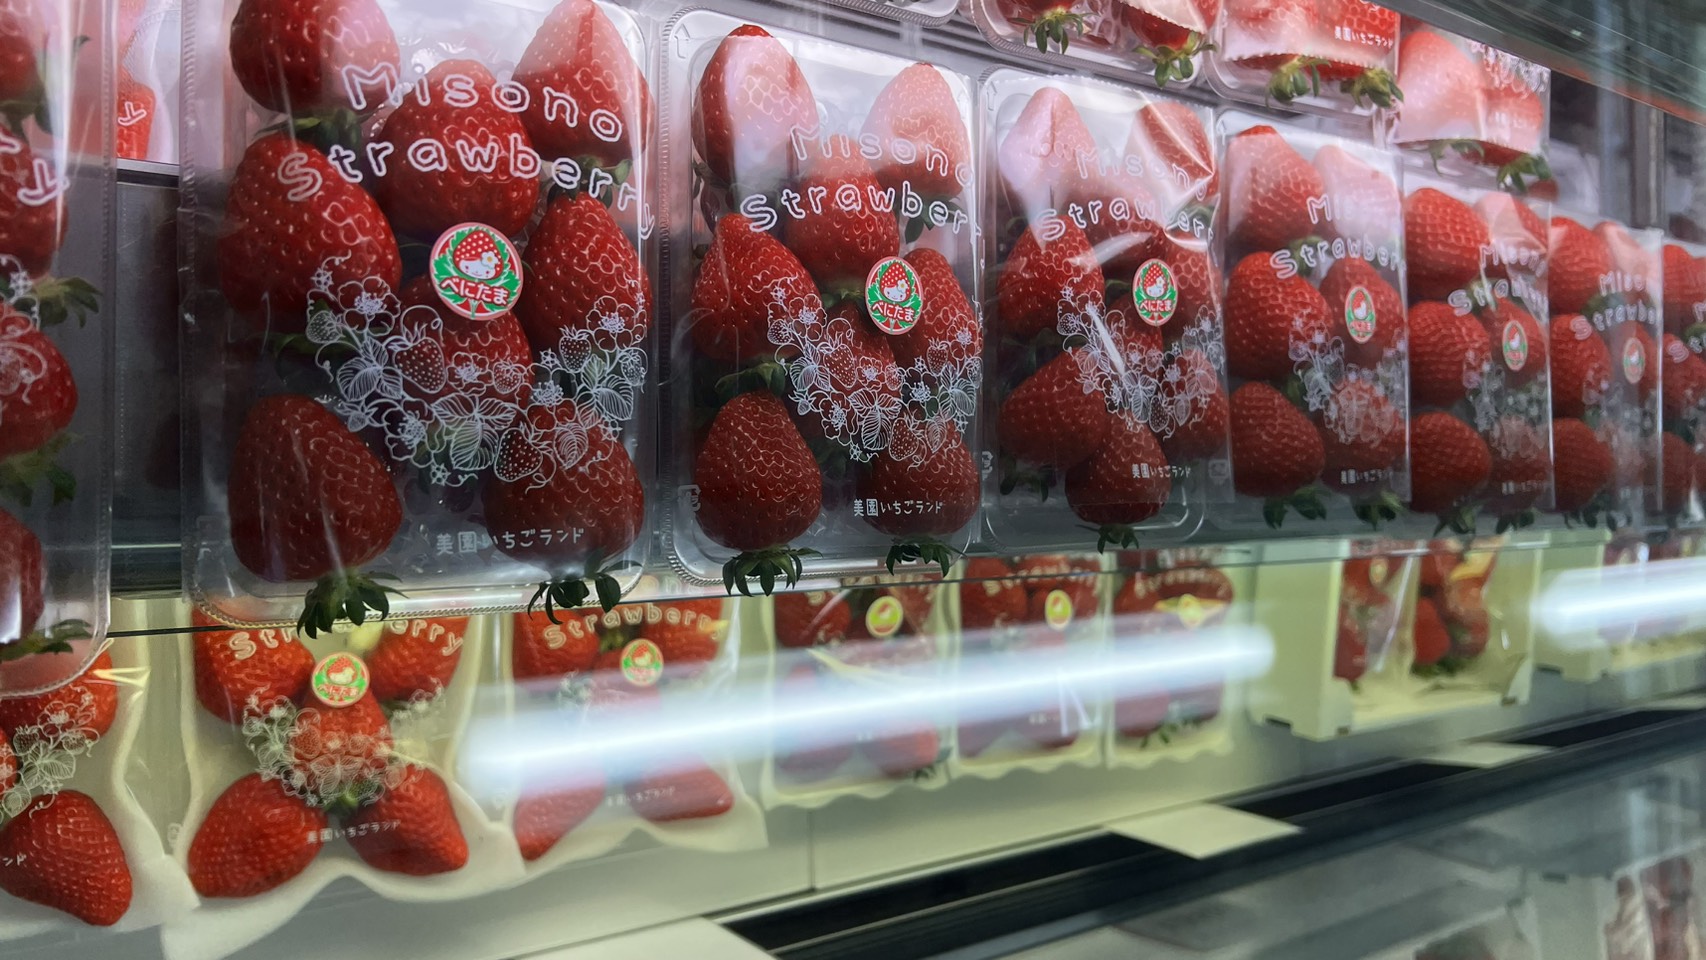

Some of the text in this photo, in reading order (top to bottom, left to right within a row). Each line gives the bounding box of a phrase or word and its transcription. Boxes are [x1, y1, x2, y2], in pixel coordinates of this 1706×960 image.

[341, 62, 622, 143] Misono
[440, 275, 509, 306] べにたま
[872, 300, 915, 322] べにたま
[853, 498, 945, 517] 美園いちごランド
[435, 527, 585, 556] 美園いちごランド
